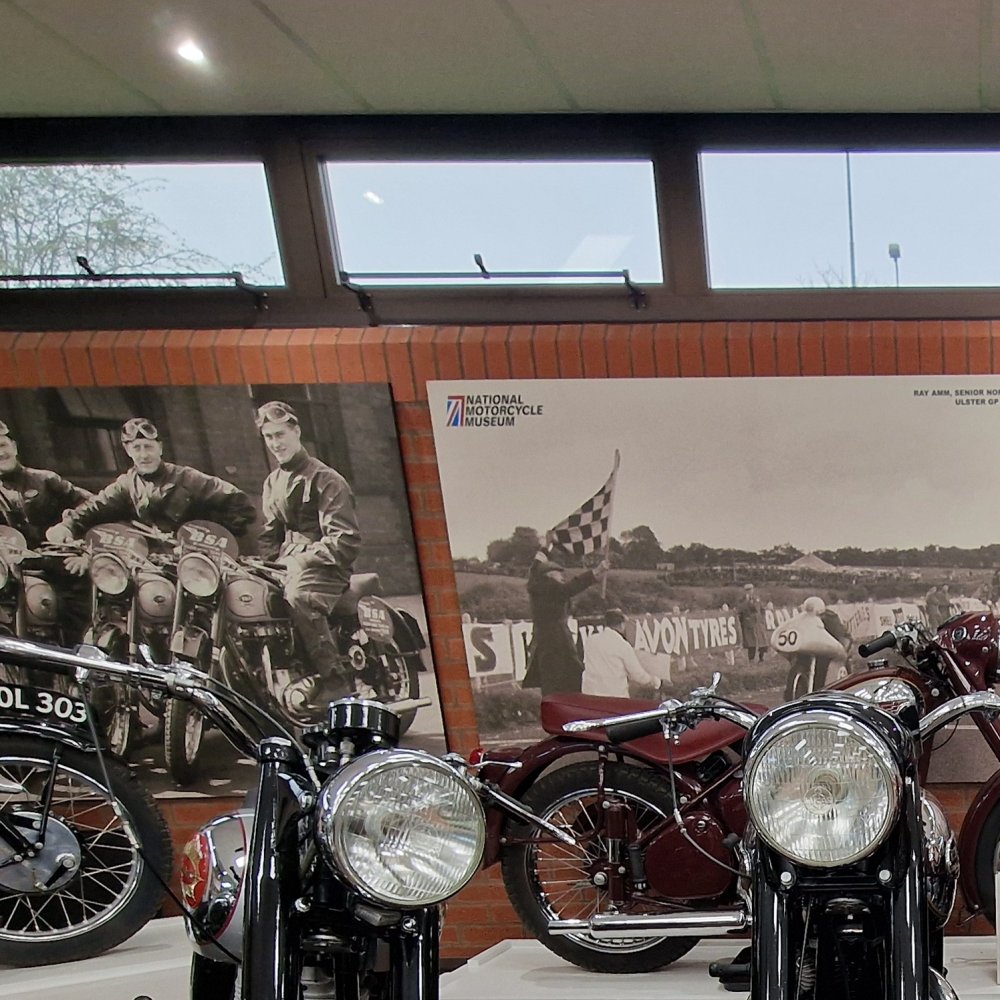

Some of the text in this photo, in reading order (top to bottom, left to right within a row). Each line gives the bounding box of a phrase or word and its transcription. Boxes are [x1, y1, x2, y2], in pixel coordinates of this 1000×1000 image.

[466, 395, 524, 404] NATIONAL
[466, 405, 544, 416] MOTORCYCLE
[465, 416, 515, 427] MUSEUM
[189, 532, 228, 547] BSA
[363, 608, 386, 620] BSA
[634, 616, 688, 655] AVON
[688, 616, 737, 650] TYRES
[778, 630, 798, 646] 50
[36, 692, 87, 722] 303
